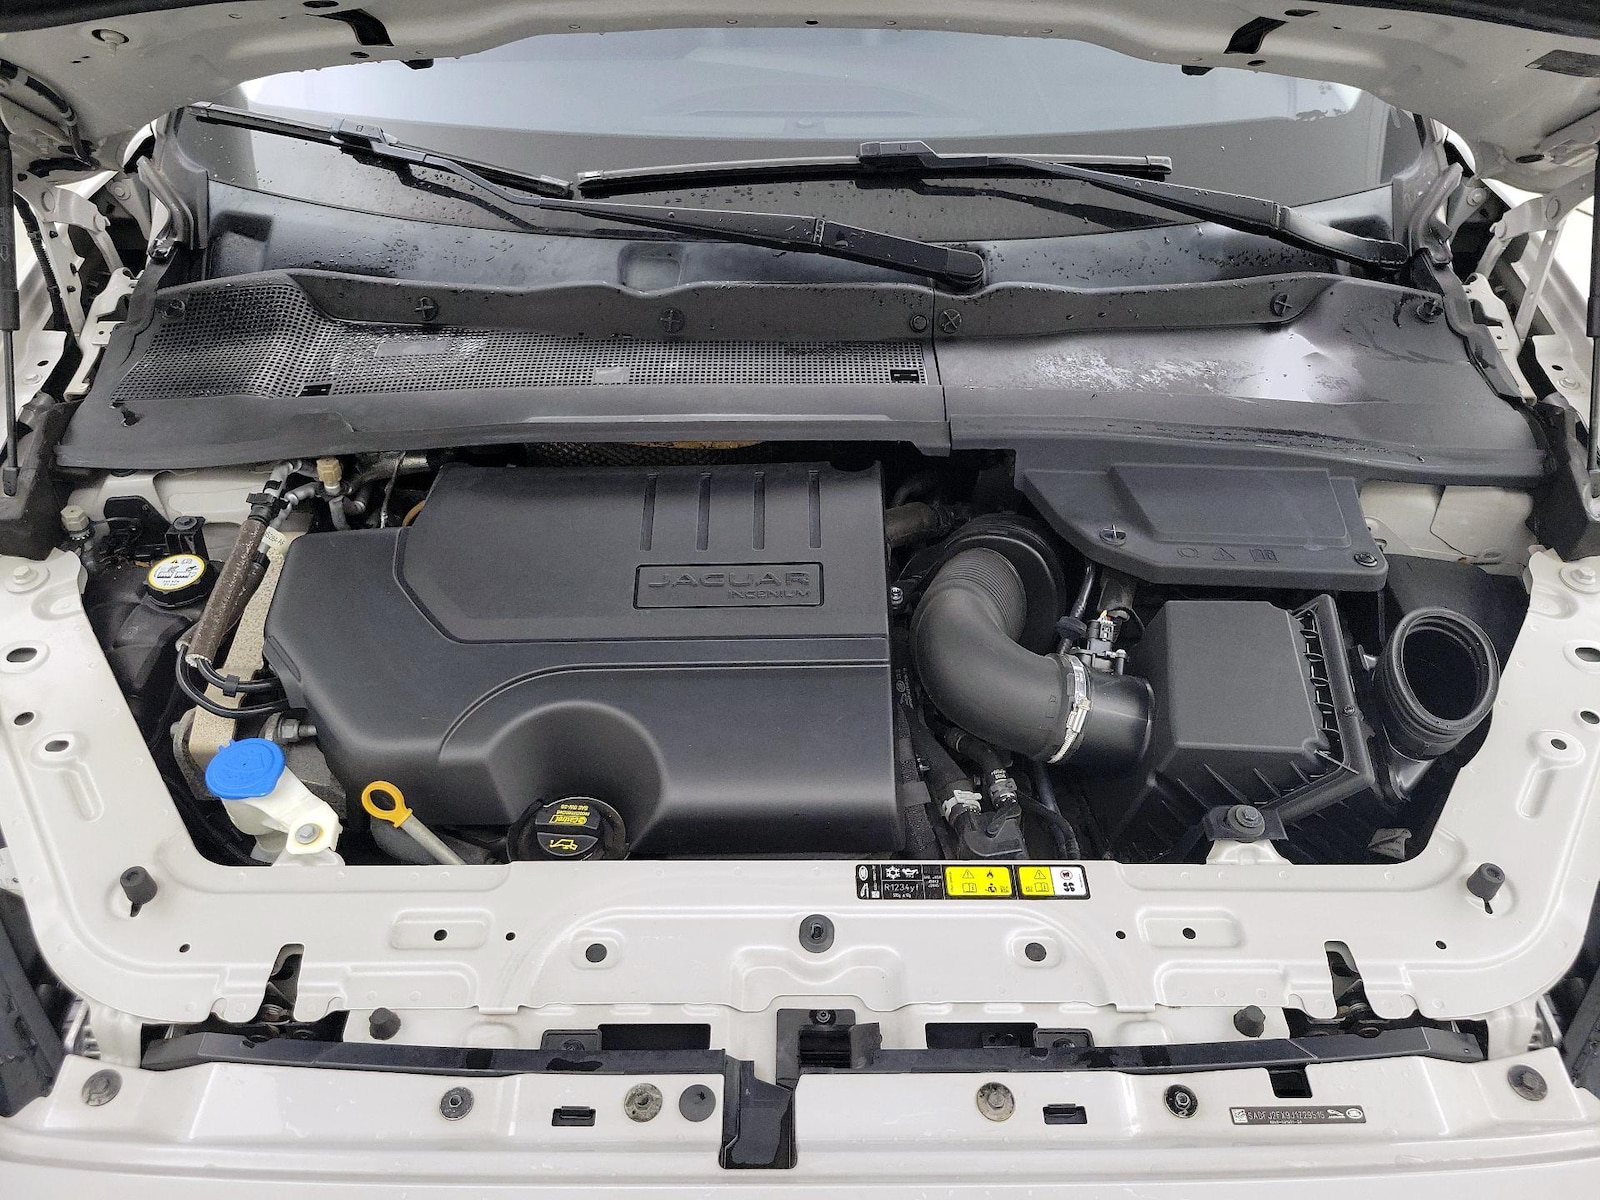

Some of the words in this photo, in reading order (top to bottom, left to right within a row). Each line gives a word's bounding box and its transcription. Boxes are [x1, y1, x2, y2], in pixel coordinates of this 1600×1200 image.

[648, 571, 811, 588] JAGUAR
[727, 588, 811, 600] INGENIUM
[884, 883, 919, 893] R1234yf
